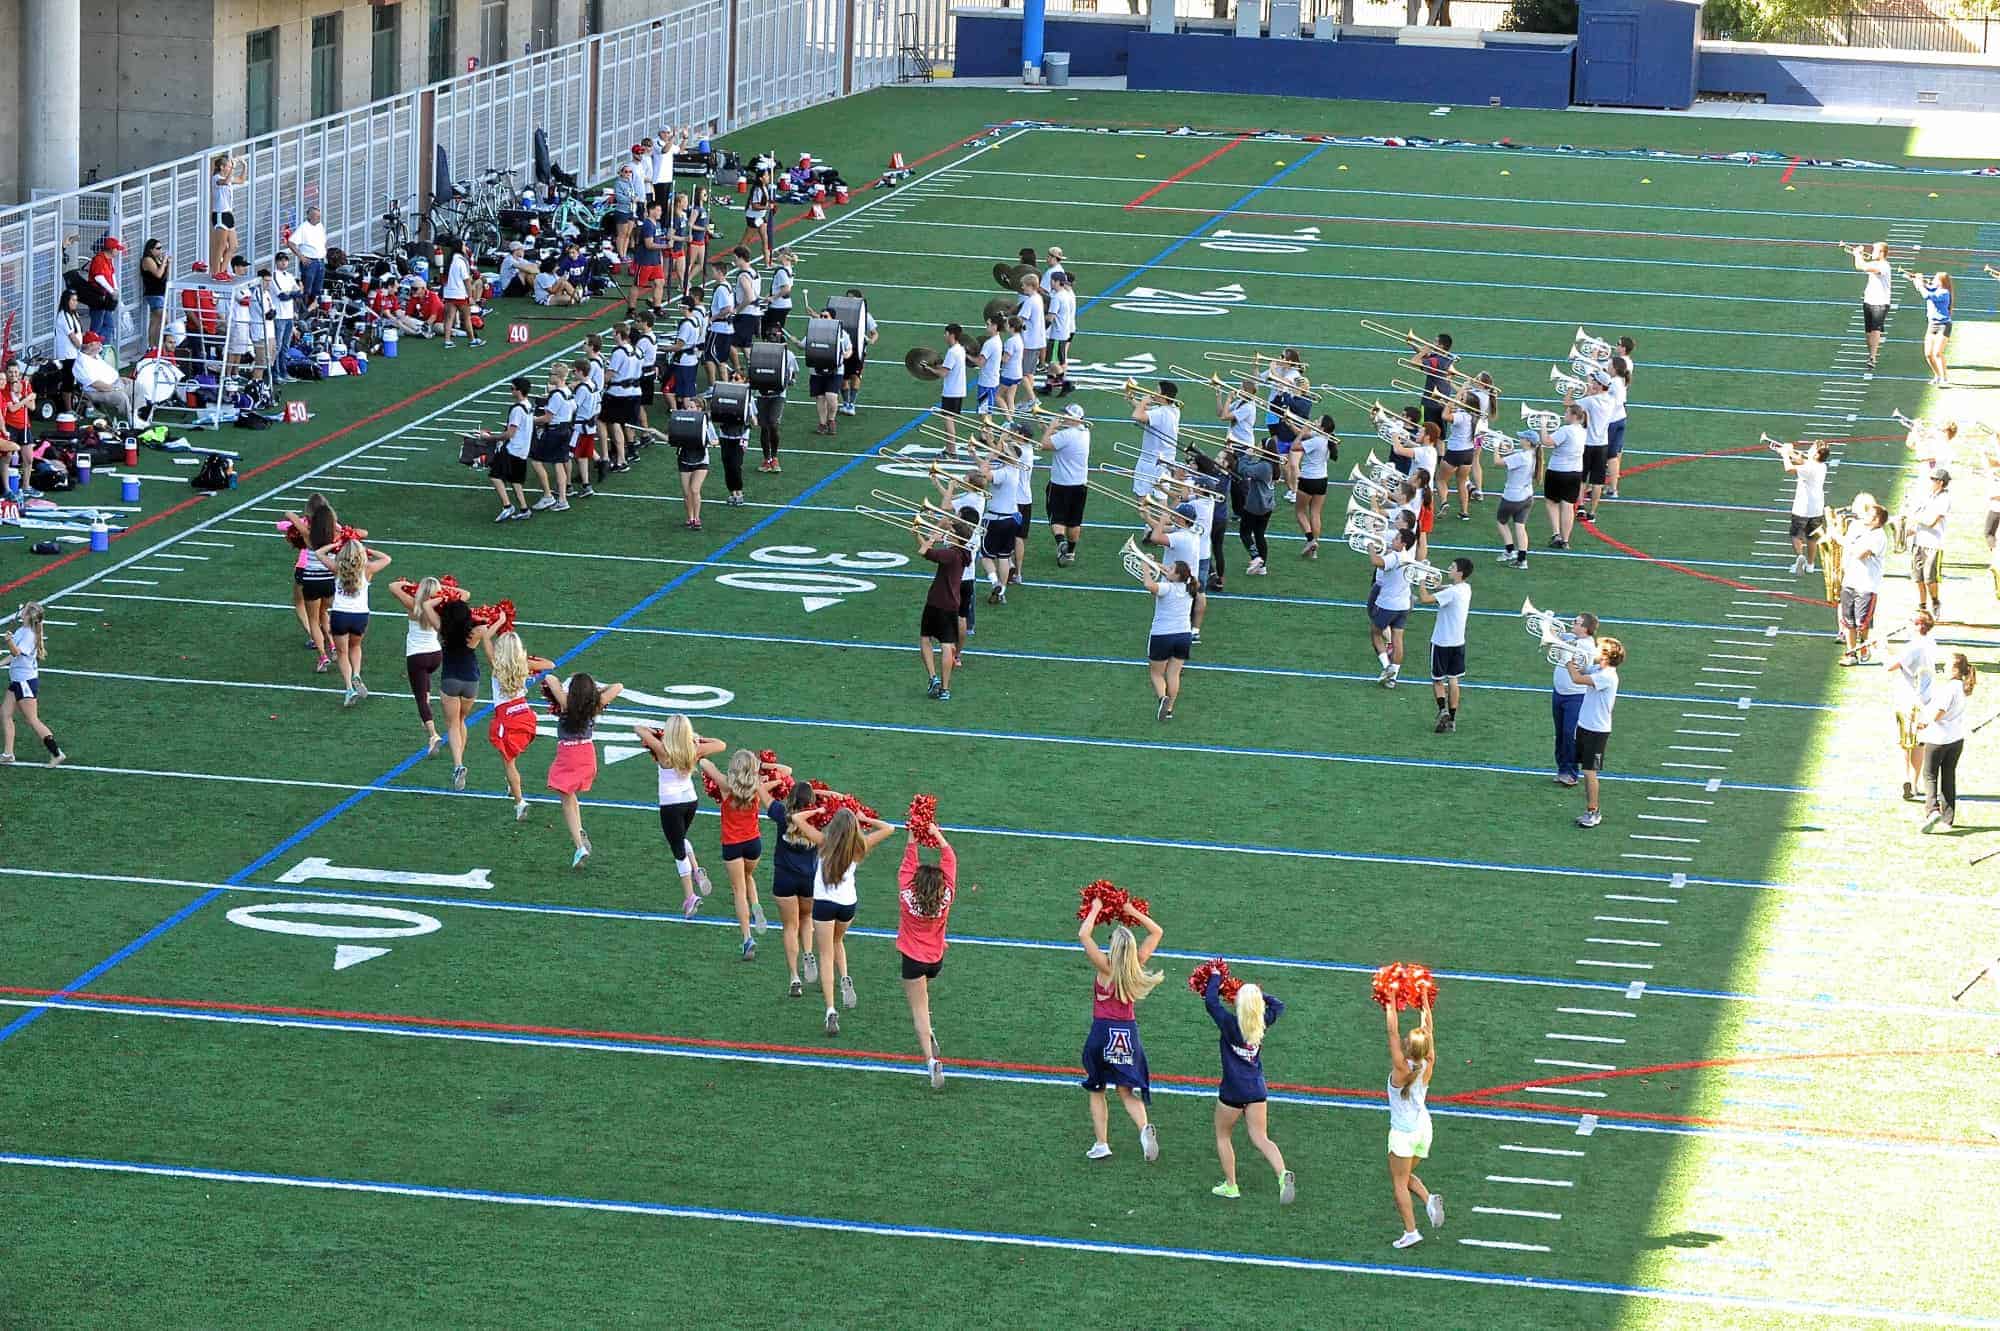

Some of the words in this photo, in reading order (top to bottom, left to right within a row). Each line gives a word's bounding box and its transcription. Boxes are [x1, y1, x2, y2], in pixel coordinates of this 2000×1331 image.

[1200, 229, 1319, 252] 10
[1109, 286, 1245, 314] 20
[510, 325, 528, 342] 40
[290, 402, 306, 421] 50
[714, 545, 909, 594] 30
[226, 856, 493, 938] 10
[1104, 1027, 1133, 1056] A
